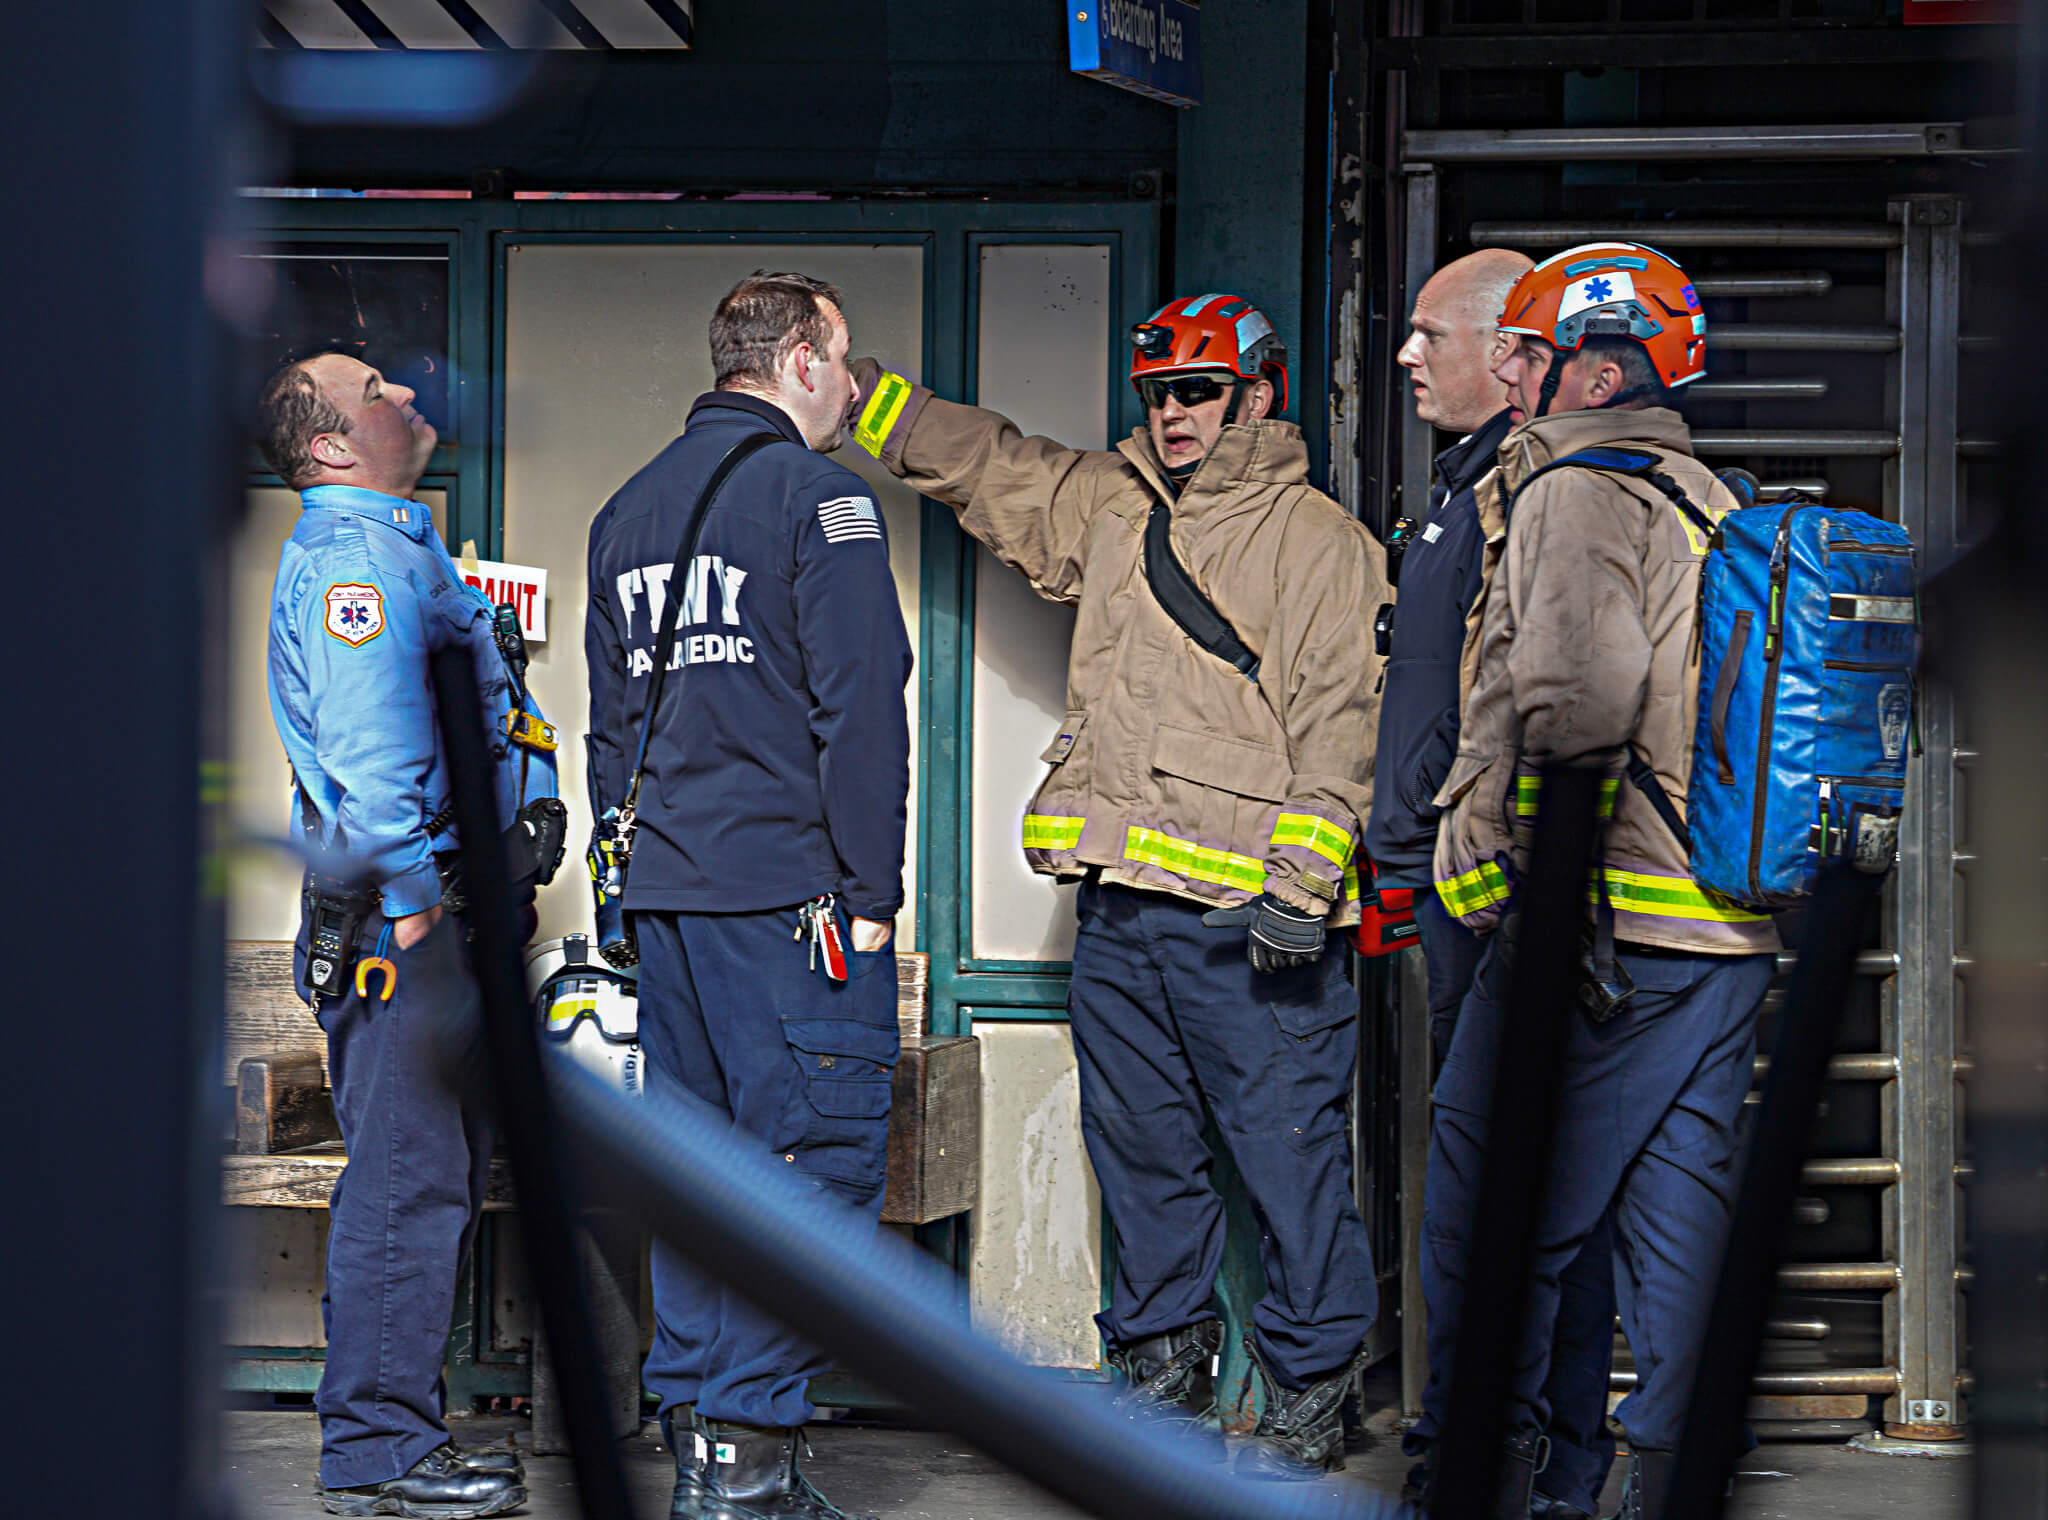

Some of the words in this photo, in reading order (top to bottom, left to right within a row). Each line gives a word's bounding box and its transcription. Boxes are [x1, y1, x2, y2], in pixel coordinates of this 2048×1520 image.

[1110, 0, 1156, 64] Boarding
[1160, 3, 1183, 61] Area
[464, 574, 538, 632] AINT
[626, 633, 756, 678] AAEDIC
